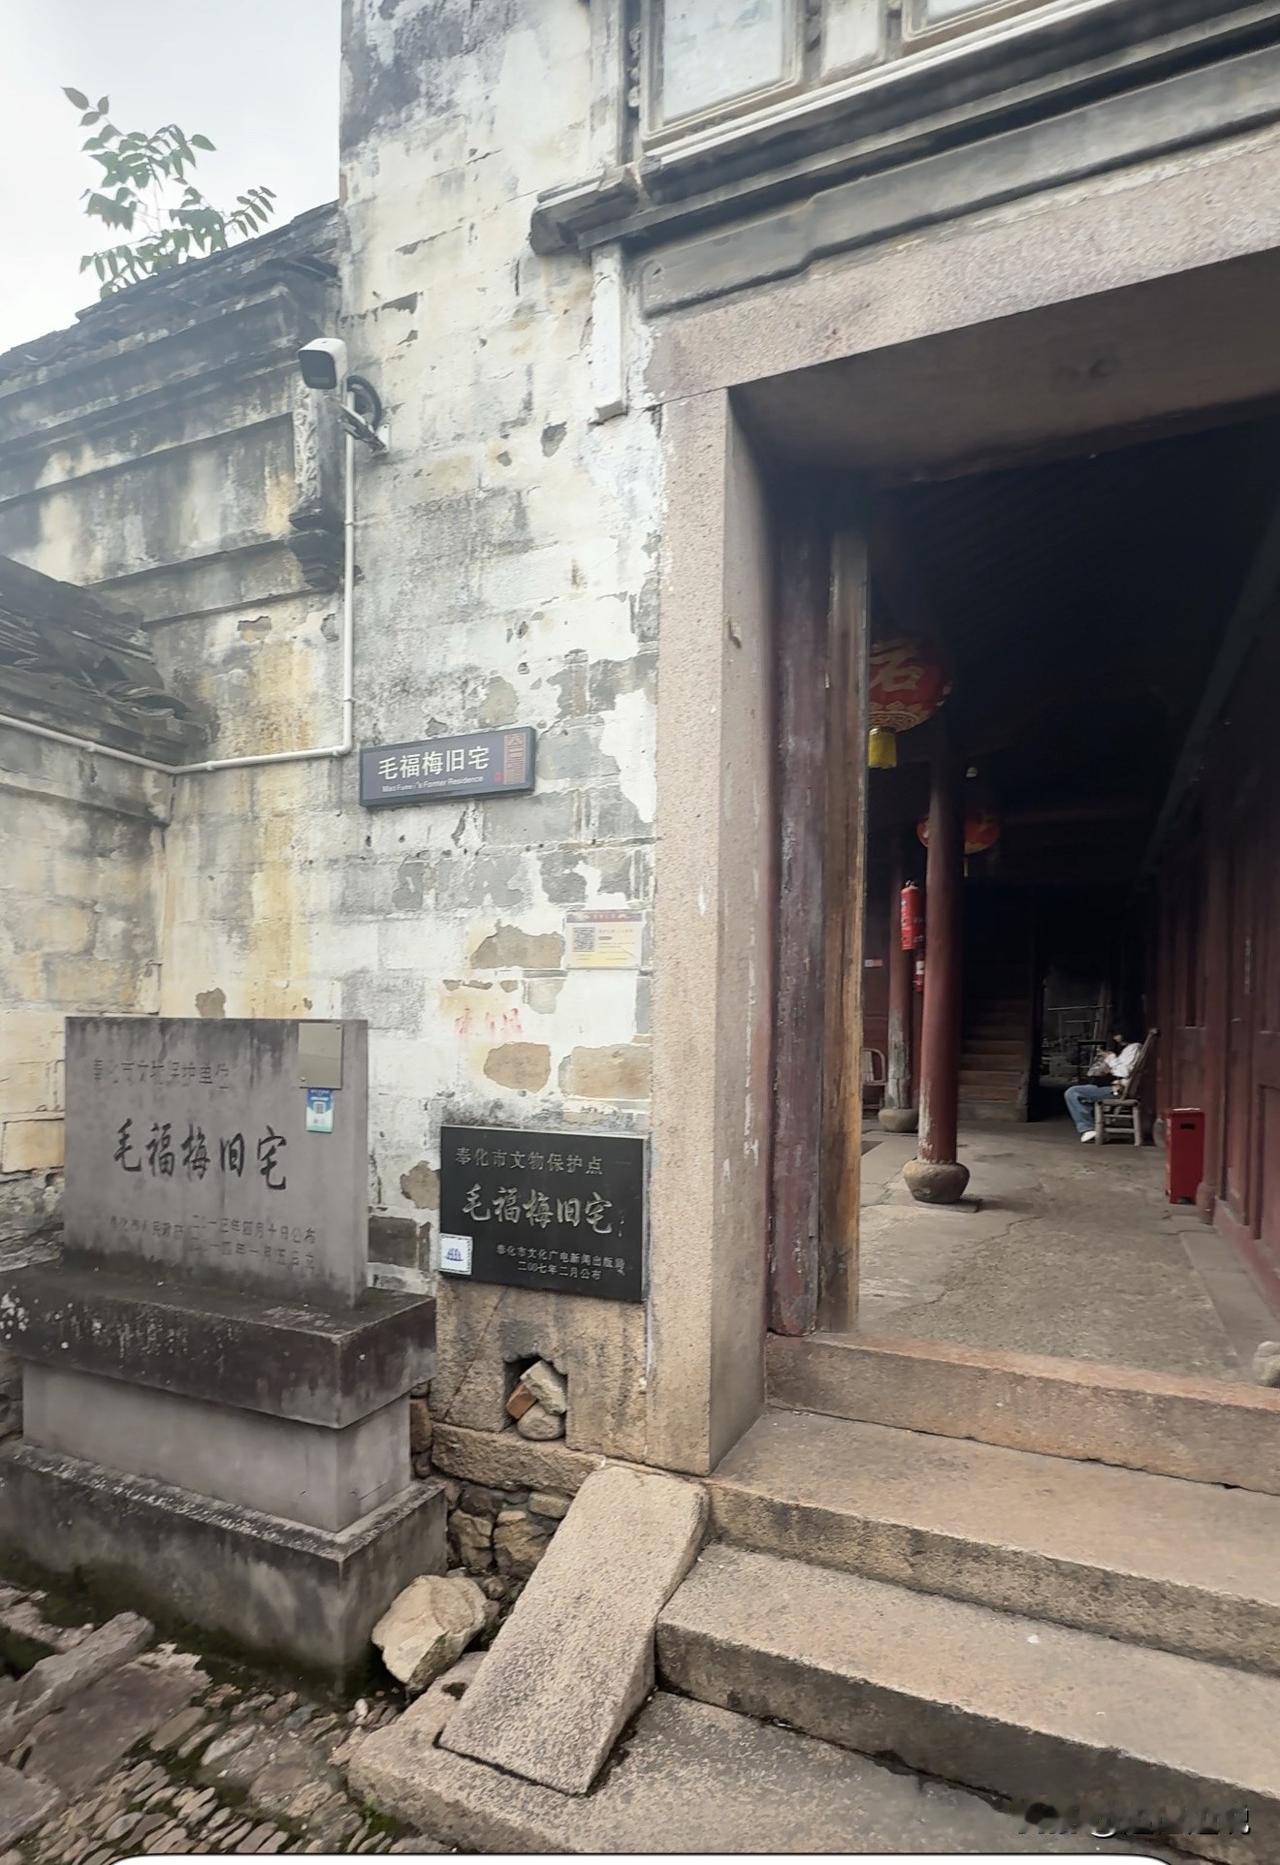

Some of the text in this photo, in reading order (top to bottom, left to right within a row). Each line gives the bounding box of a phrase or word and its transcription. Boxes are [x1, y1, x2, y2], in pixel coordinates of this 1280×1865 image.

[378, 746, 490, 780] 毛福梅旧宅
[424, 779, 447, 788] Former
[448, 776, 484, 786] Residence
[114, 1118, 287, 1191] 毛福梅旧宅
[456, 1147, 603, 1175] 奉化市文物保护点
[462, 1183, 613, 1234] 毛福梅旧宅
[496, 1245, 626, 1276] 奉化市文化广电新闻出版局
